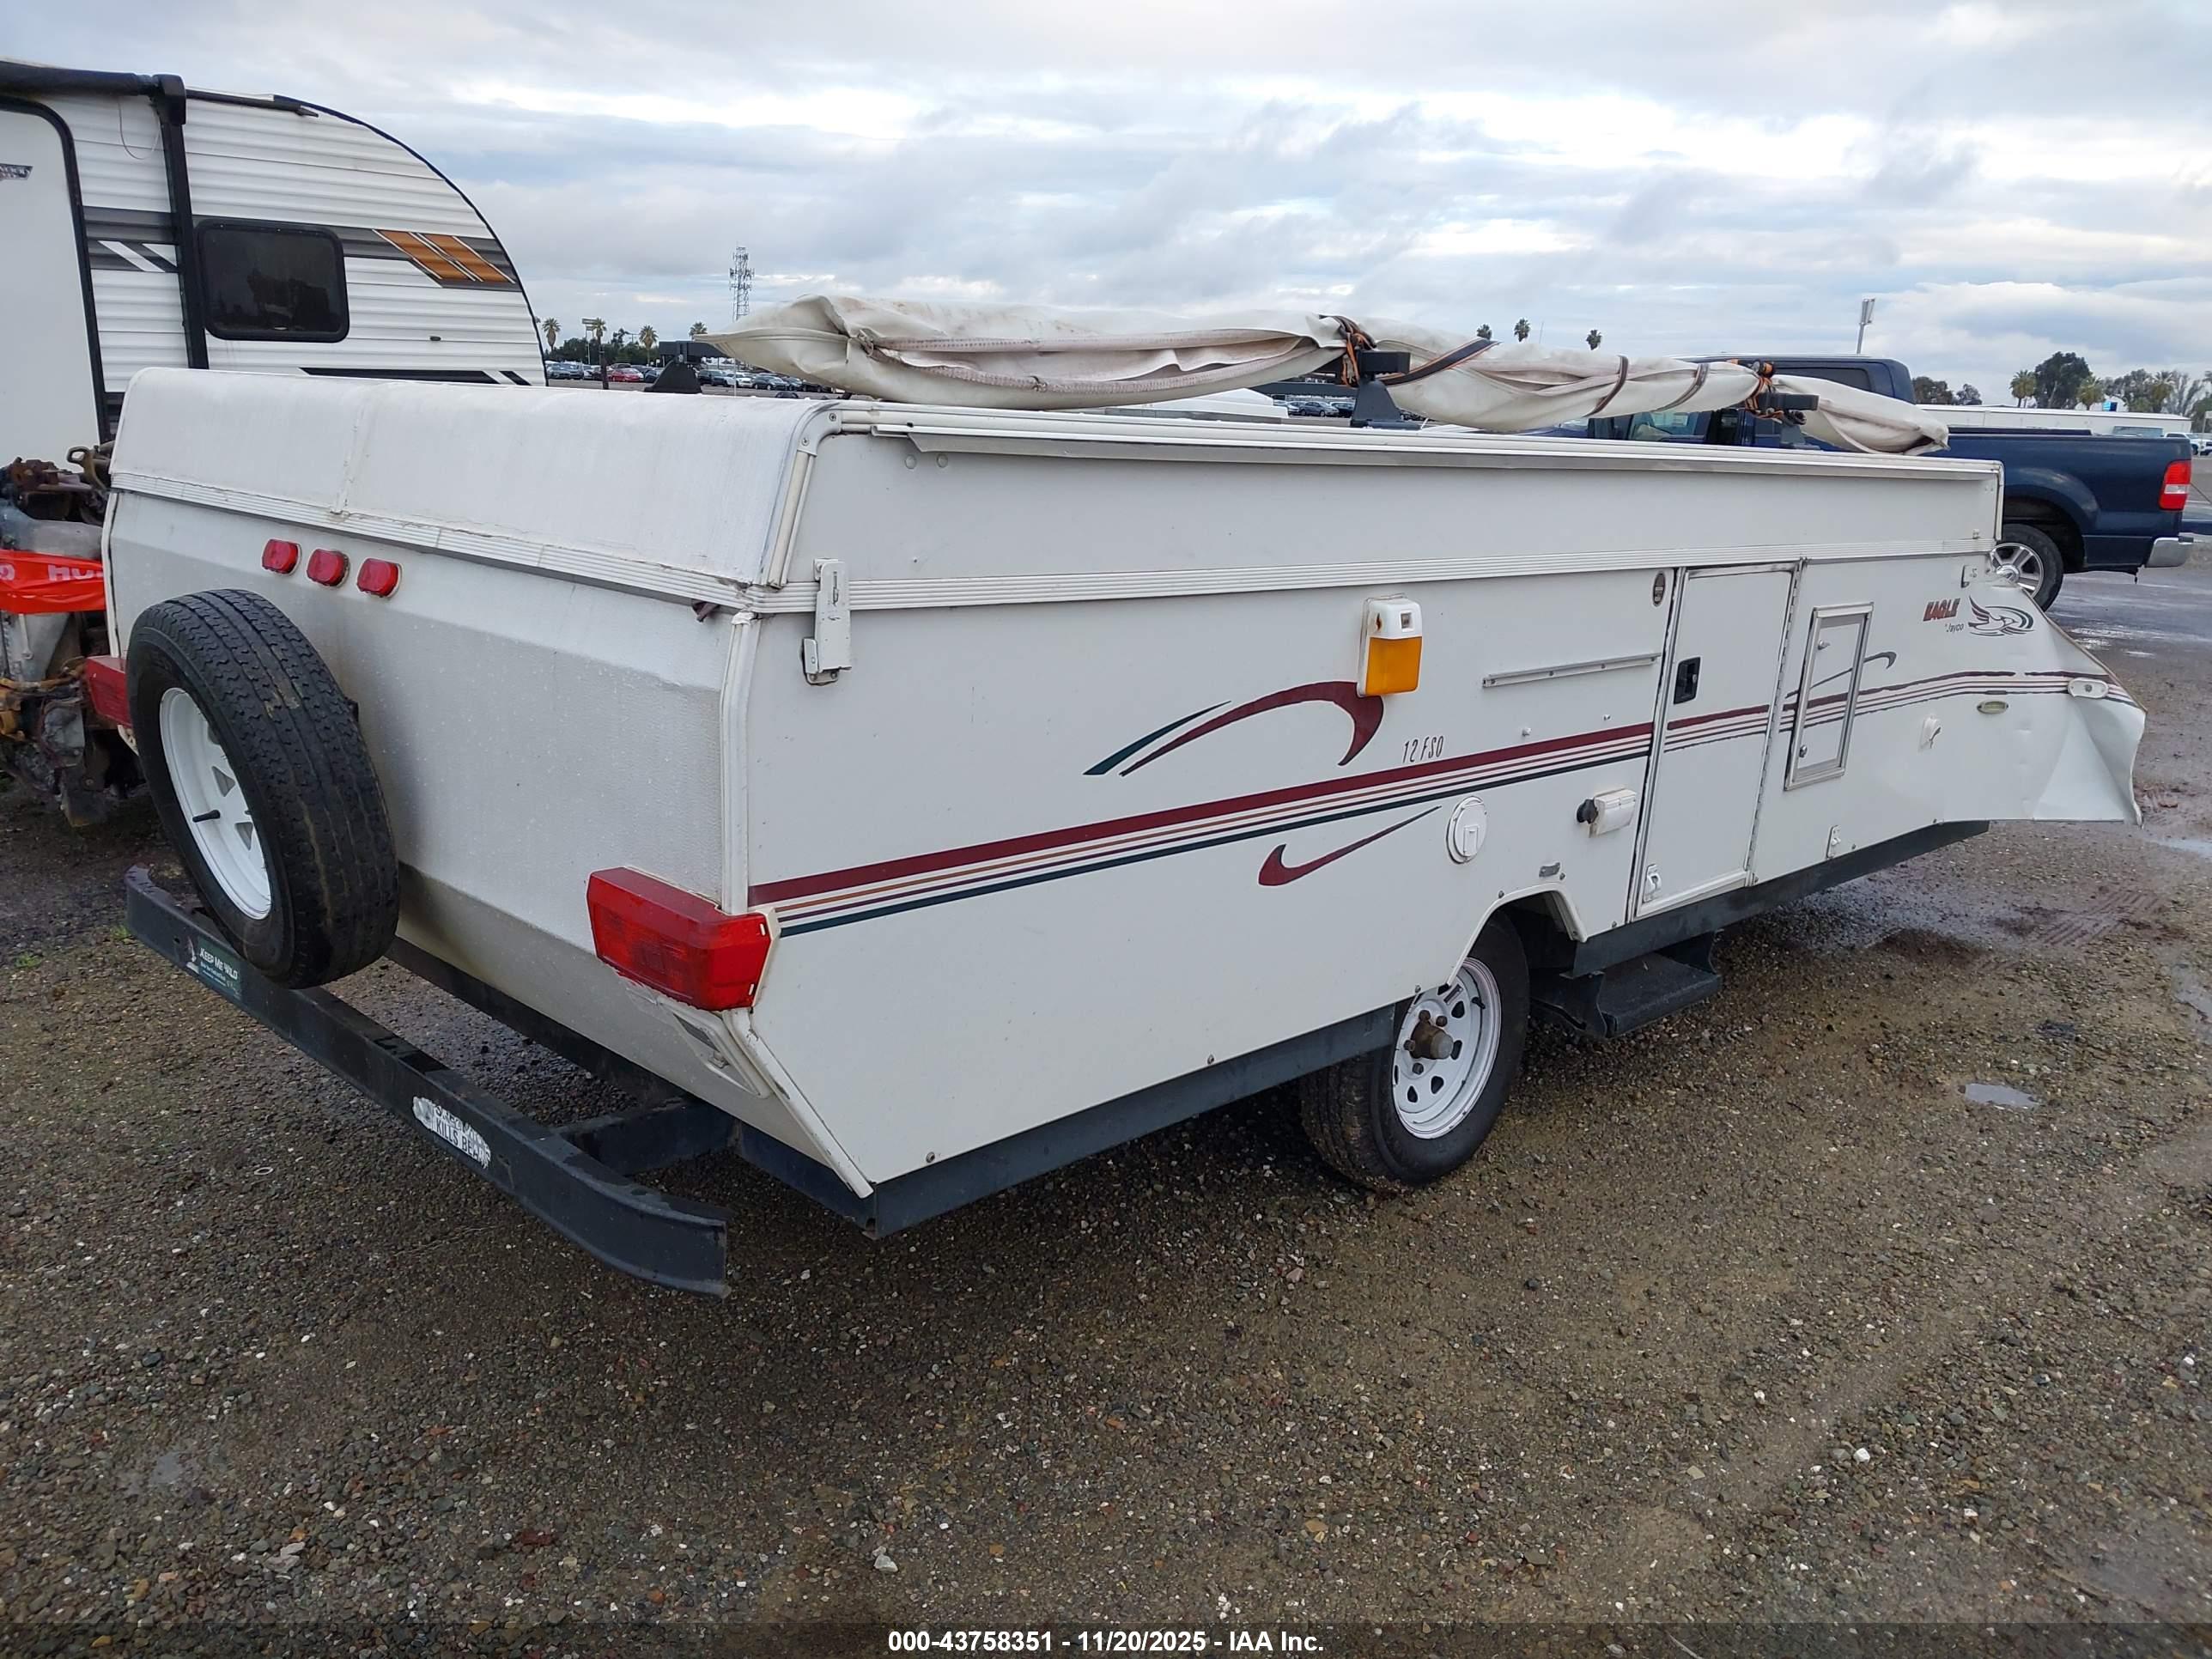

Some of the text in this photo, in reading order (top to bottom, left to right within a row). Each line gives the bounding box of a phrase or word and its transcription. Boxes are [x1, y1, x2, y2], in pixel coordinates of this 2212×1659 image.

[1923, 599, 1960, 622] EAGLE
[1402, 739, 1419, 763] 12
[435, 1116, 459, 1146] KILLS
